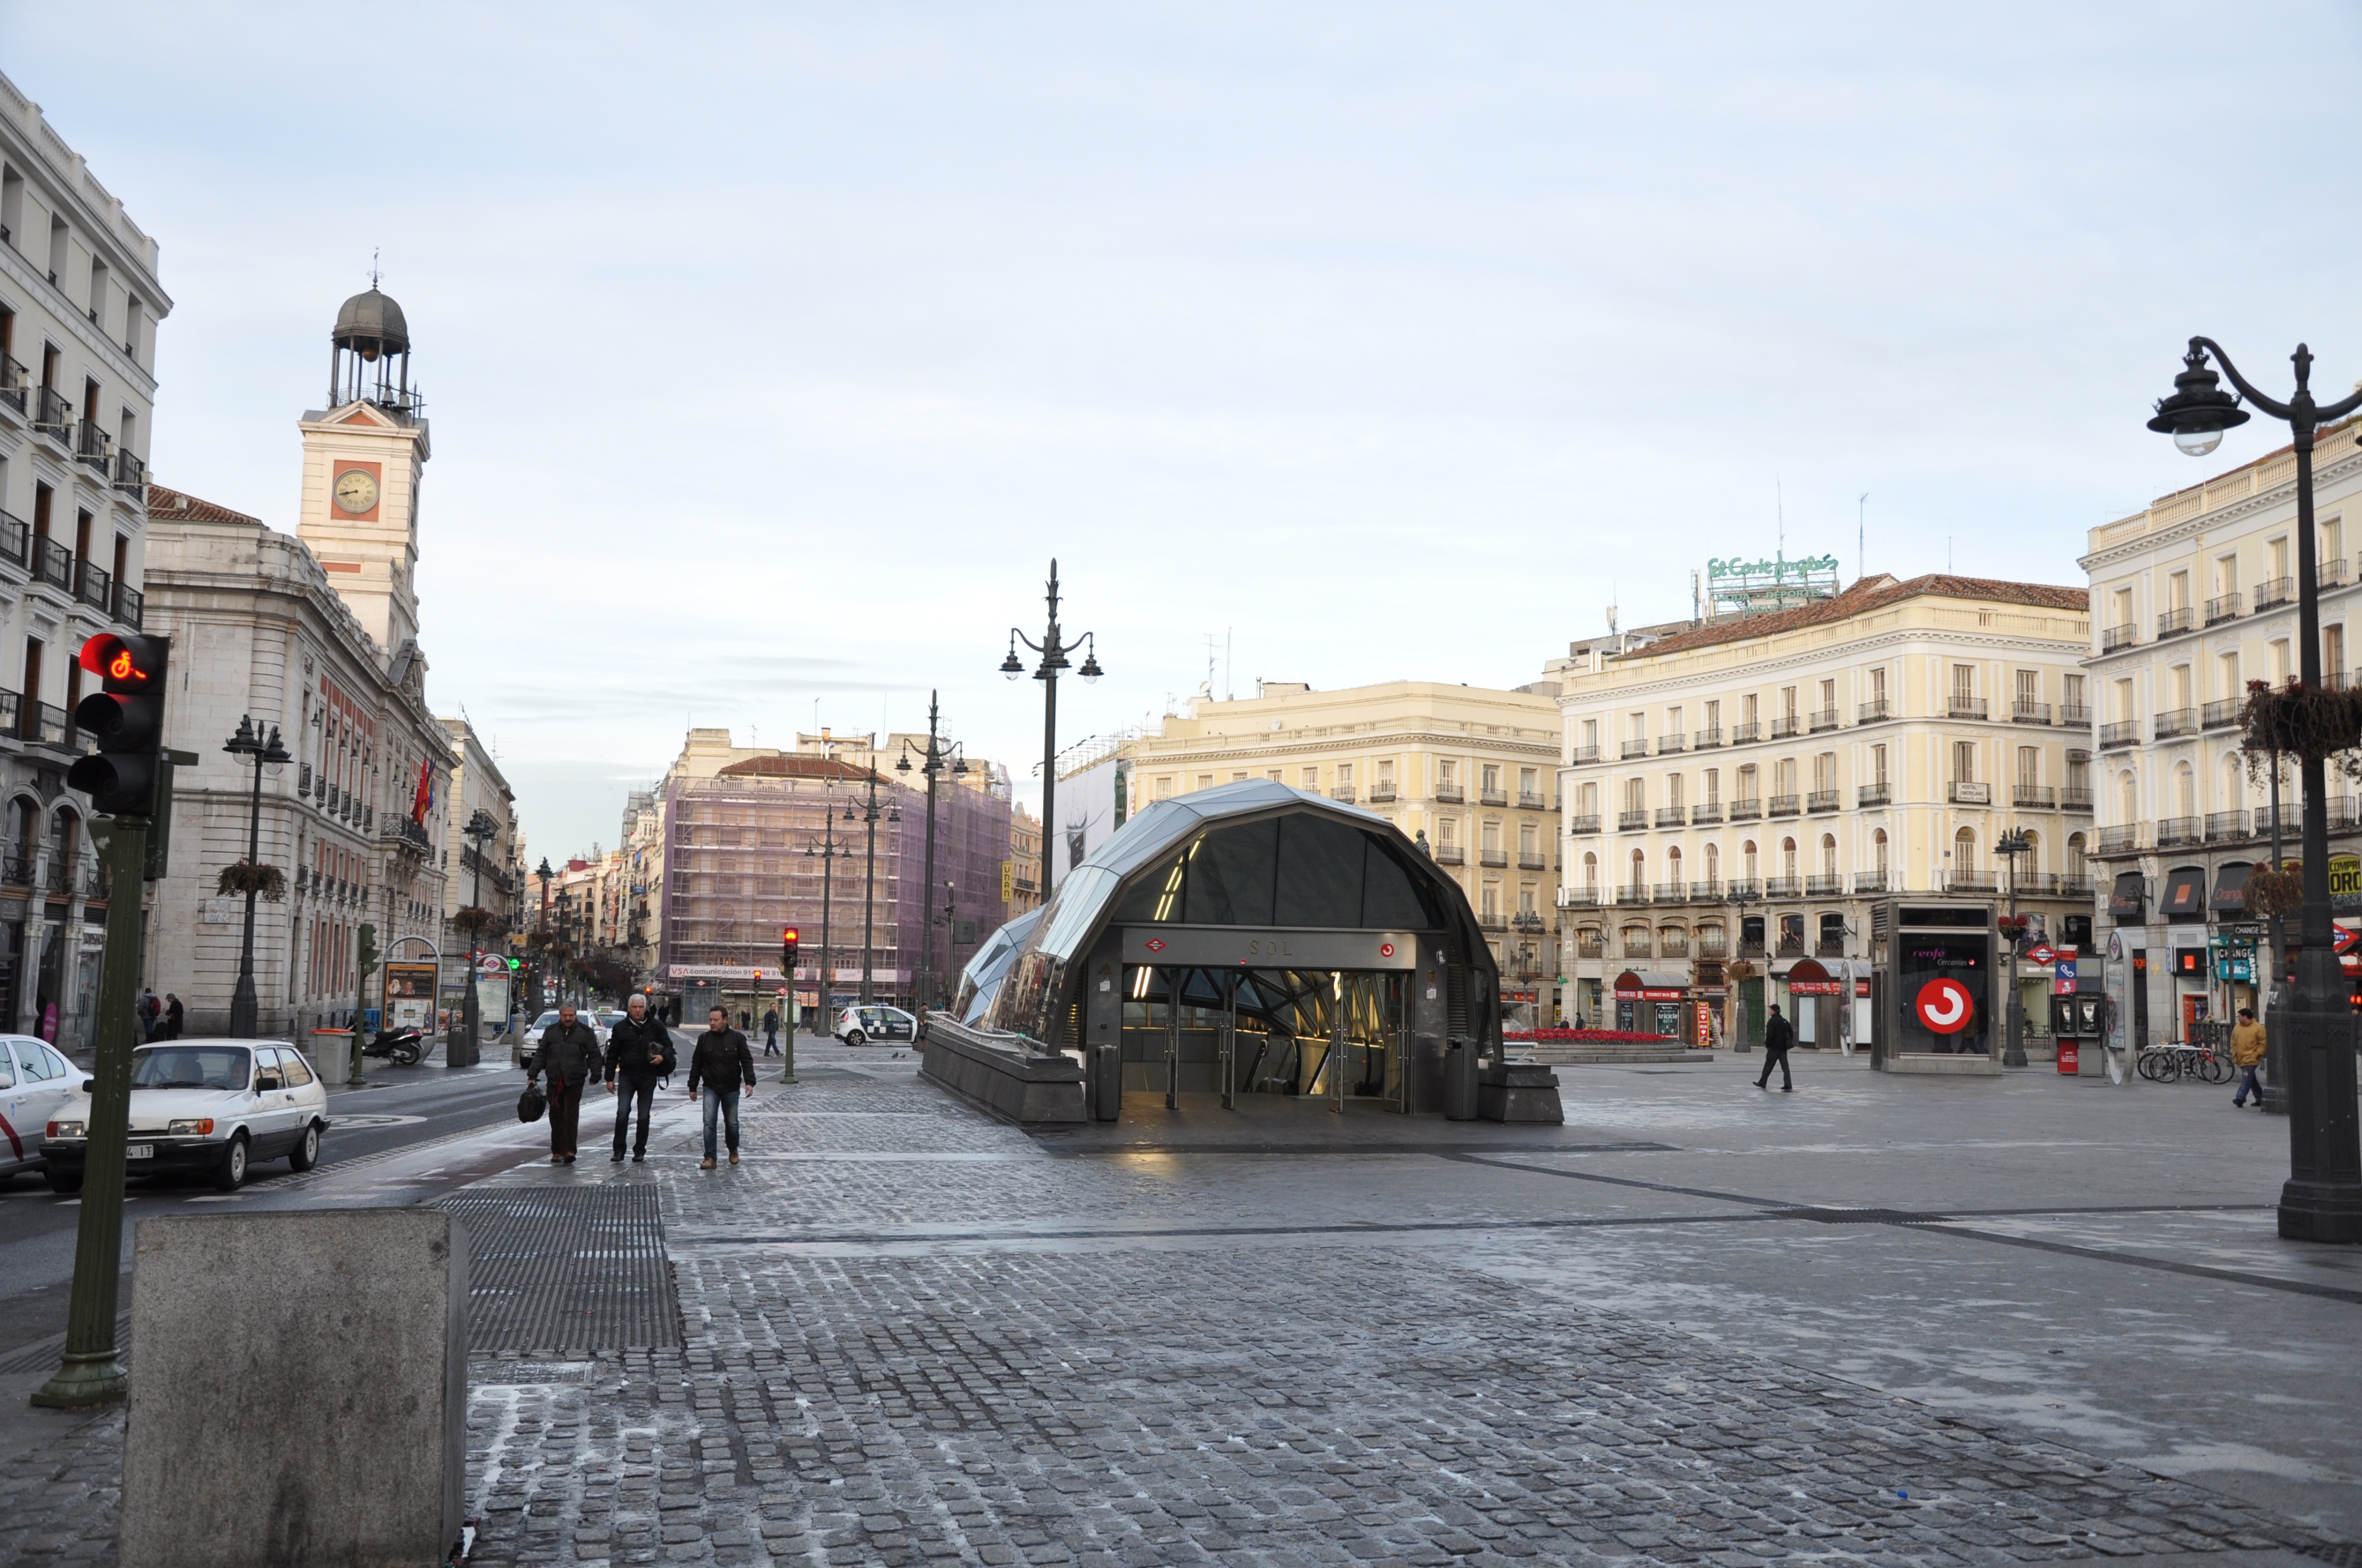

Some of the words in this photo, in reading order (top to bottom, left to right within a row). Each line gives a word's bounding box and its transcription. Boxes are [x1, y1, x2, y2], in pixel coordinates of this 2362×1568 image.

[1708, 558, 1727, 578] El
[1729, 558, 1772, 575] Corte
[1775, 550, 1839, 580] Inglés
[1716, 594, 1750, 602] MODA
[1766, 588, 1825, 600] DEPORTES
[1250, 940, 1293, 956] SOL
[1913, 948, 1945, 961] renfe
[2219, 948, 2251, 958] CHNGE
